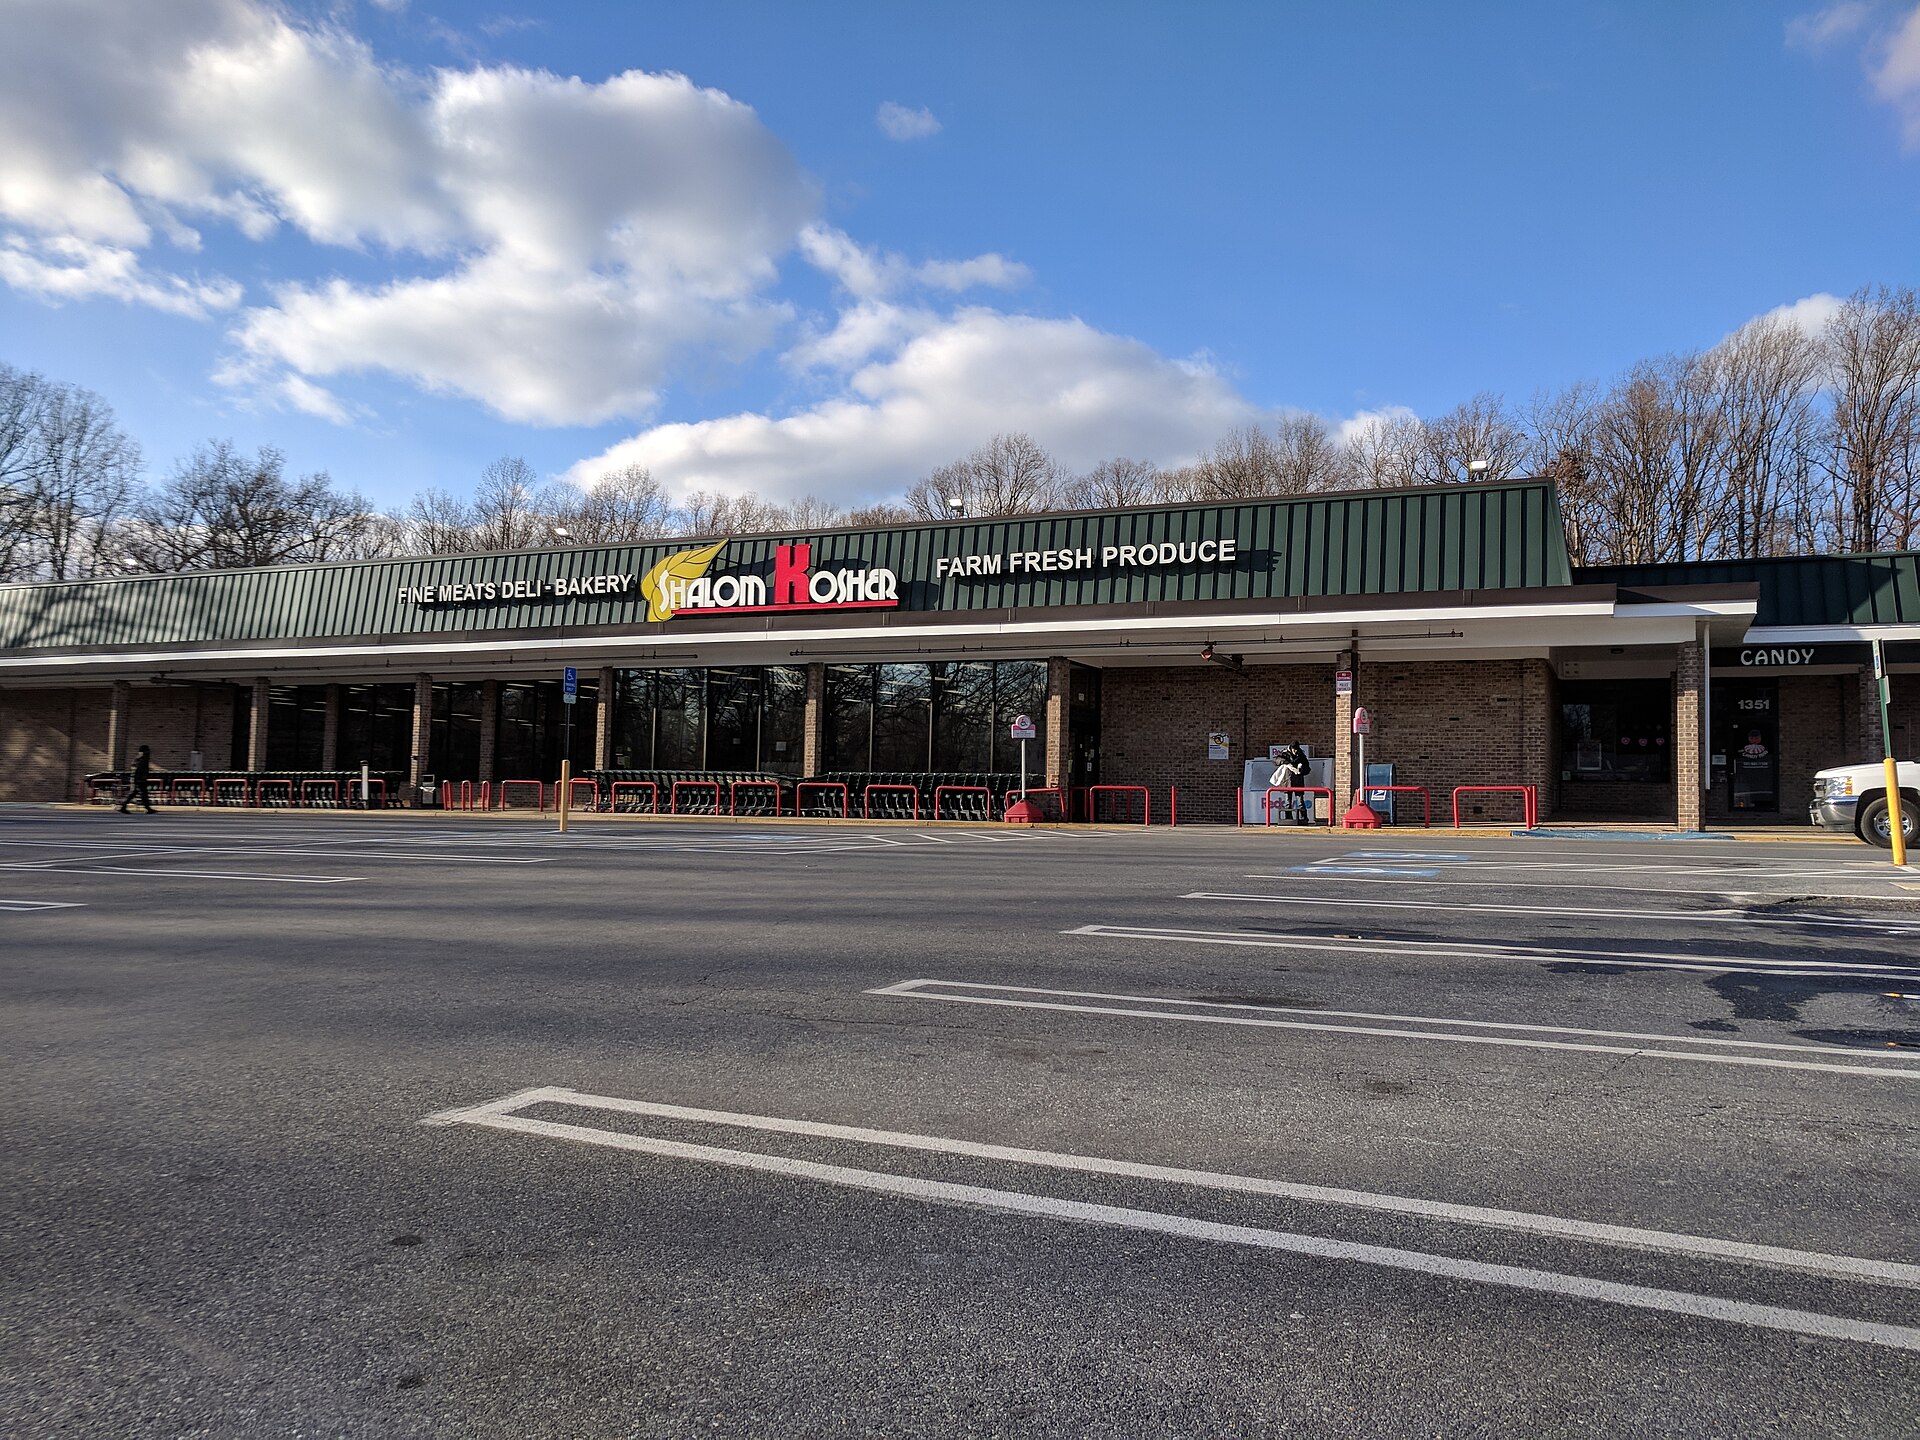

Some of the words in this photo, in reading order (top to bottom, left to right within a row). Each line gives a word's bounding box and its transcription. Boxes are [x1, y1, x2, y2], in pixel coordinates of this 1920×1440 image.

[936, 554, 1001, 578] FARM
[1009, 548, 1092, 573] FRESH
[1102, 539, 1236, 568] PRODUCE
[397, 586, 434, 604] FINE
[438, 582, 496, 602] MEATS
[501, 579, 541, 599] DELI
[554, 573, 634, 596] BAKERY
[659, 569, 766, 613] SHALOM
[774, 543, 899, 605] KOSHER
[1740, 648, 1815, 666] CANDY
[1737, 699, 1770, 710] 1351
